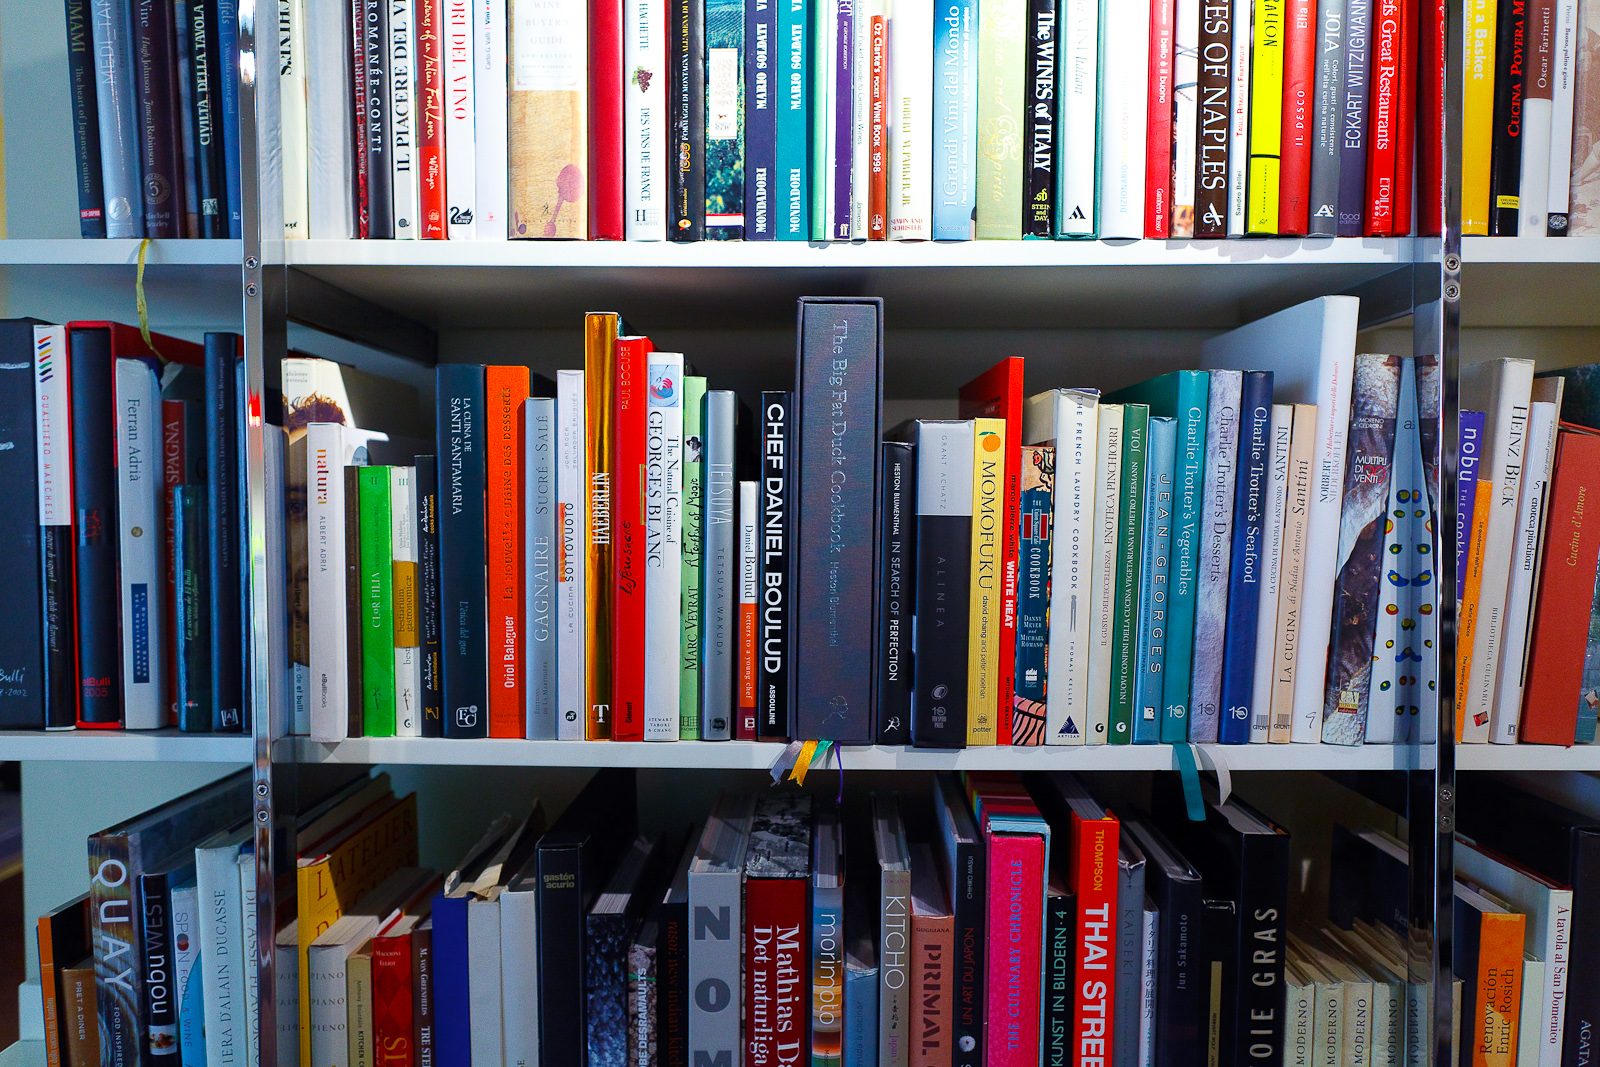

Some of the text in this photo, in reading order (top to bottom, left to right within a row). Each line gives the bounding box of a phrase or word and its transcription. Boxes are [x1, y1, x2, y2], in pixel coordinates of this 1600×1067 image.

[639, 3, 649, 51] HACHETTE
[945, 6, 960, 66] Mondo
[1297, 7, 1308, 29] Elia
[1324, 9, 1341, 54] JOIA
[1537, 7, 1550, 88] Oscar Farinetti
[367, 1, 383, 154] ROMANÉE-CONTI
[394, 22, 410, 172] IL PIACERE DEL
[944, 71, 959, 95] del
[1033, 10, 1055, 172] The WINES of ITALY
[1329, 59, 1339, 83] Colori,
[1329, 86, 1337, 105] gusti
[1377, 19, 1397, 150] Great Restaurants
[1508, 20, 1524, 137] CUCINA POVERA
[640, 108, 650, 201] DES VINS DE FRANCE
[756, 23, 768, 233] MONDADORI MARIO SOLDATI
[790, 24, 802, 233] MONDADORI MARIO SOLDATI
[944, 99, 959, 134] Vini
[1201, 43, 1227, 190] OF NAPLES
[1328, 114, 1336, 155] consistenze
[1346, 92, 1363, 148] ECKART
[943, 139, 958, 195] Grandi
[620, 347, 631, 410] PAUL BOCUSE
[126, 398, 143, 482] Ferran Adrià
[166, 420, 180, 483] SPAGNA
[450, 398, 463, 515] SANTI SANTAMARIA
[827, 319, 849, 553] The Big Fat Duck Cookbook
[1129, 428, 1141, 453] JOIA
[1329, 430, 1343, 503] NIEDERKOFLER
[1501, 404, 1528, 507] HEINZ BECK
[316, 449, 329, 505] natura
[592, 471, 610, 545] HAEBERLIN
[647, 411, 663, 569] GEORGES BLANC
[665, 435, 679, 544] The Natural Cuisine of
[710, 461, 734, 526] TETSUYA
[1127, 500, 1136, 525] PIETRO
[1128, 461, 1139, 498] LEEMANN
[1177, 406, 1201, 596] Charlie Trotter's Vegetables
[1209, 406, 1233, 583] Charlie Trotter's Desserts
[1243, 406, 1267, 584] Charlie Trotter's Seafood
[1319, 458, 1332, 503] NORBERT
[764, 403, 785, 725] CHEF DANIEL BOULUD ASSOULINE
[978, 460, 996, 590] MOMOFUKU
[1004, 474, 1018, 628] marco pierre white WHITE HEAT
[1124, 537, 1134, 586] VEGETARIANA
[1127, 526, 1135, 535] DI
[1523, 497, 1540, 572] enoteca pinchiorri
[534, 535, 549, 642] GAGNAIRE
[716, 548, 725, 657] TETSUYA WAKUDA
[888, 462, 901, 681] HESTON BLUMENTHAL IN SEARCH OF PERFECTION
[936, 556, 946, 627] ALINEA
[1028, 547, 1041, 599] COOKBOOK
[1123, 587, 1132, 618] CUCINA
[1150, 474, 1171, 674] JEAN-GEORGES
[503, 615, 517, 688] Oriol Balaguer
[1121, 644, 1130, 674] CONFINI
[1122, 619, 1131, 642] DELLA
[1480, 607, 1499, 707] BIBLIOTHECA CULINARIA
[1119, 676, 1128, 700] NUOVI
[92, 859, 133, 990] QUAY
[1083, 829, 1109, 970] THOMPSON THAI
[146, 894, 167, 1014] nobu WEST
[214, 889, 231, 1022] D'ALAIN DUCASSE
[776, 923, 799, 1033] Mathias
[819, 914, 841, 1025] morimoto
[884, 896, 905, 989] KITCHO
[1008, 860, 1022, 1050] THE CULINARY CHRONICLE
[1123, 909, 1135, 976] KAISEKI
[1177, 914, 1187, 989] Jun Sakamoto
[1252, 908, 1278, 987] GRAS
[1549, 905, 1569, 1044] A tavola al San Domenico
[75, 981, 83, 1004] PRET
[78, 1014, 86, 1040] DINER
[749, 925, 773, 1066] Det naturliga
[922, 945, 941, 1056] PRIMAL
[1296, 999, 1307, 1065] MODERNO
[1327, 999, 1337, 1065] MODERNO
[1355, 999, 1366, 1064] MODERNO
[1480, 968, 1497, 1055] Renovación
[1497, 968, 1514, 1055] Enric Rosich
